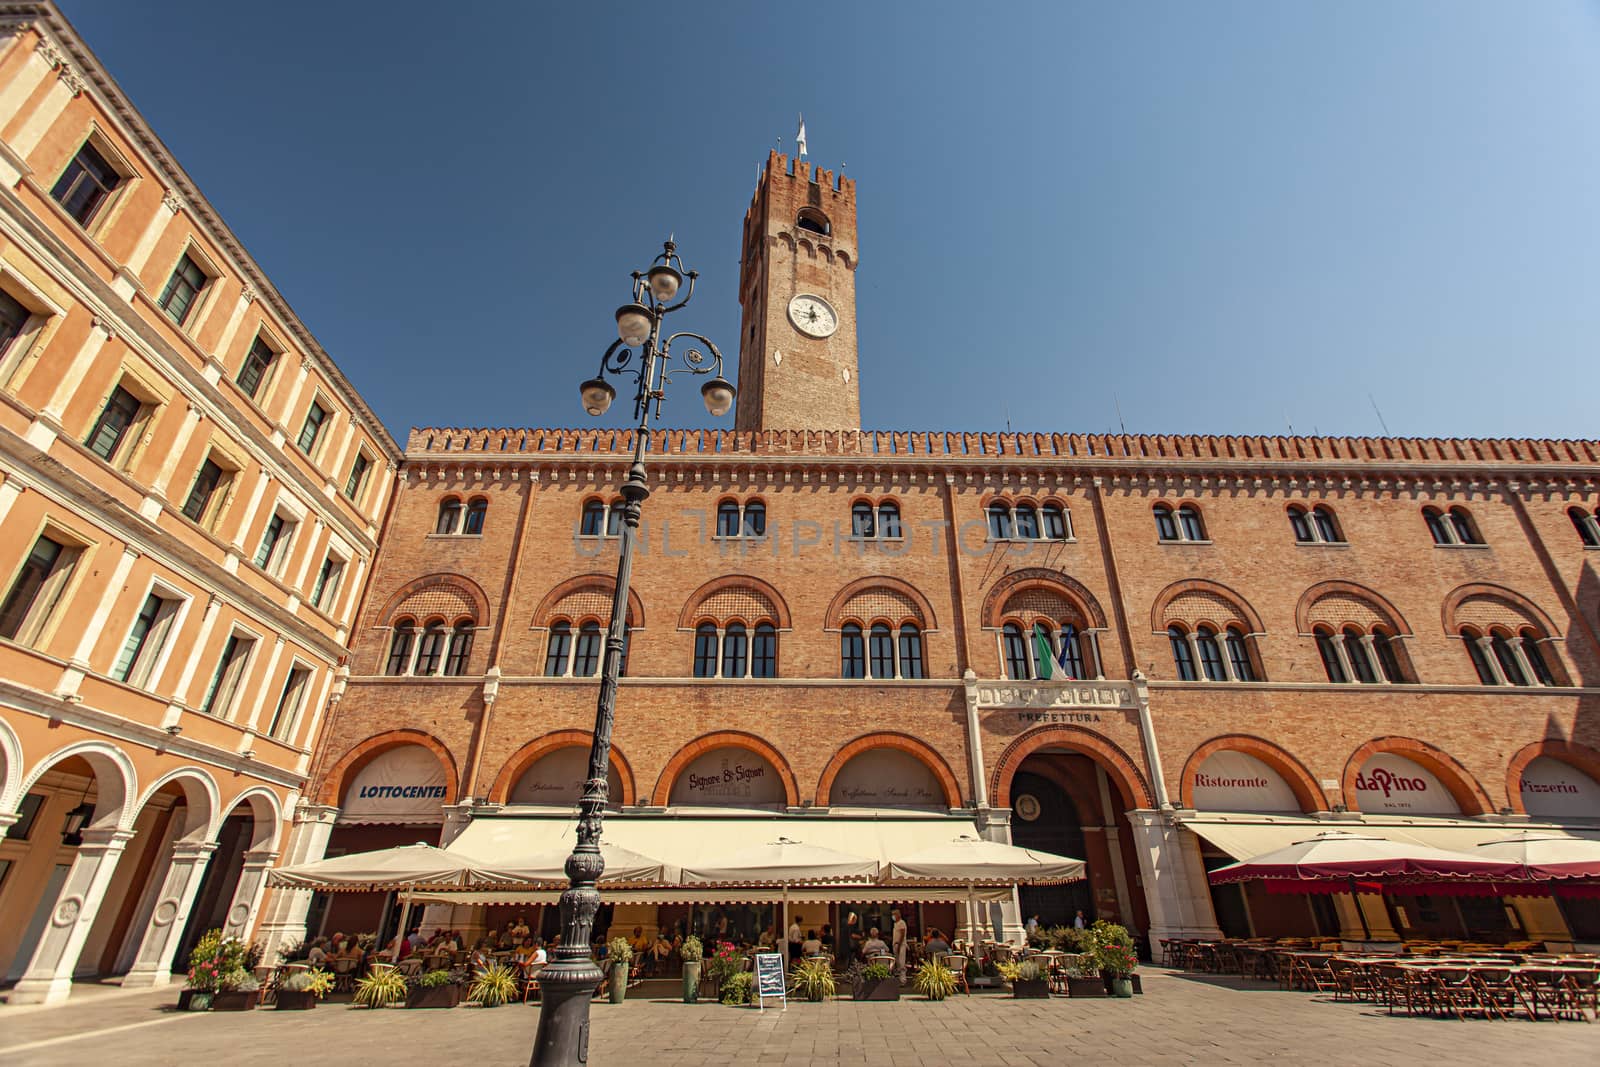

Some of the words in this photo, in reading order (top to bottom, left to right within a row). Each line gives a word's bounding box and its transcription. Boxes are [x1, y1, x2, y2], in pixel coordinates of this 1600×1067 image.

[1018, 712, 1101, 722] PREFETTURA
[689, 773, 720, 791] Signore
[735, 765, 764, 782] Signori
[1195, 773, 1268, 787] Ristorante
[1519, 779, 1578, 793] Pizzeria
